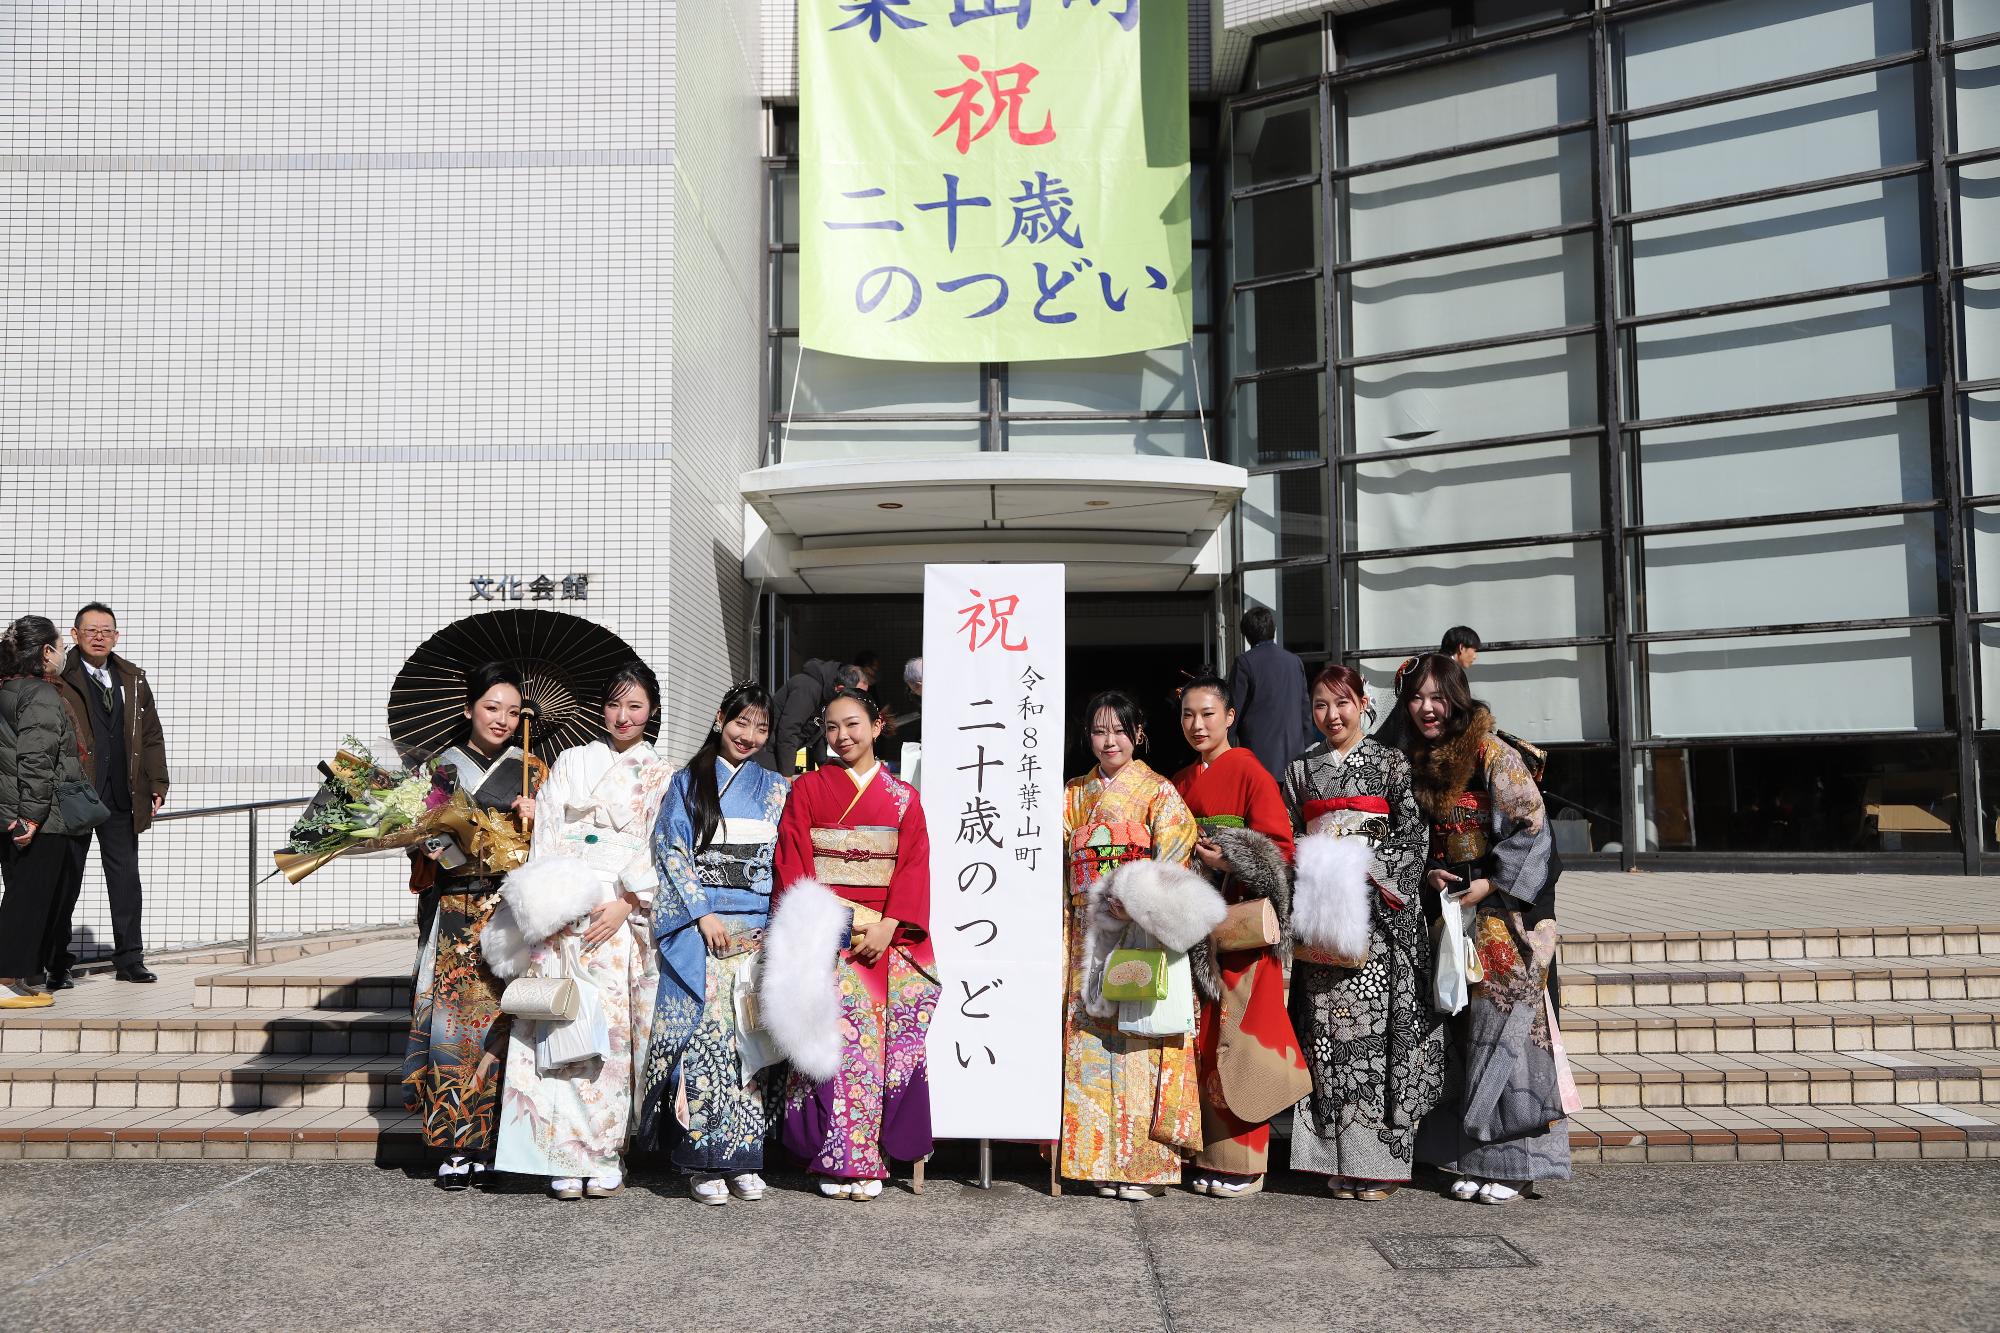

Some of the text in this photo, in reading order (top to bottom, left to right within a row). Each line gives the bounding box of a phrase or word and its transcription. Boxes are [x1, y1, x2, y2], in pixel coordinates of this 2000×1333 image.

[933, 54, 1057, 155] 祝
[823, 171, 1084, 253] 二十歳
[856, 257, 1168, 324] のつどい
[469, 574, 588, 601] 文化会館
[956, 588, 1028, 653] 祝
[1014, 665, 1046, 873] 令和8年葉山町
[954, 699, 1006, 1069] 二十歳のつどい
